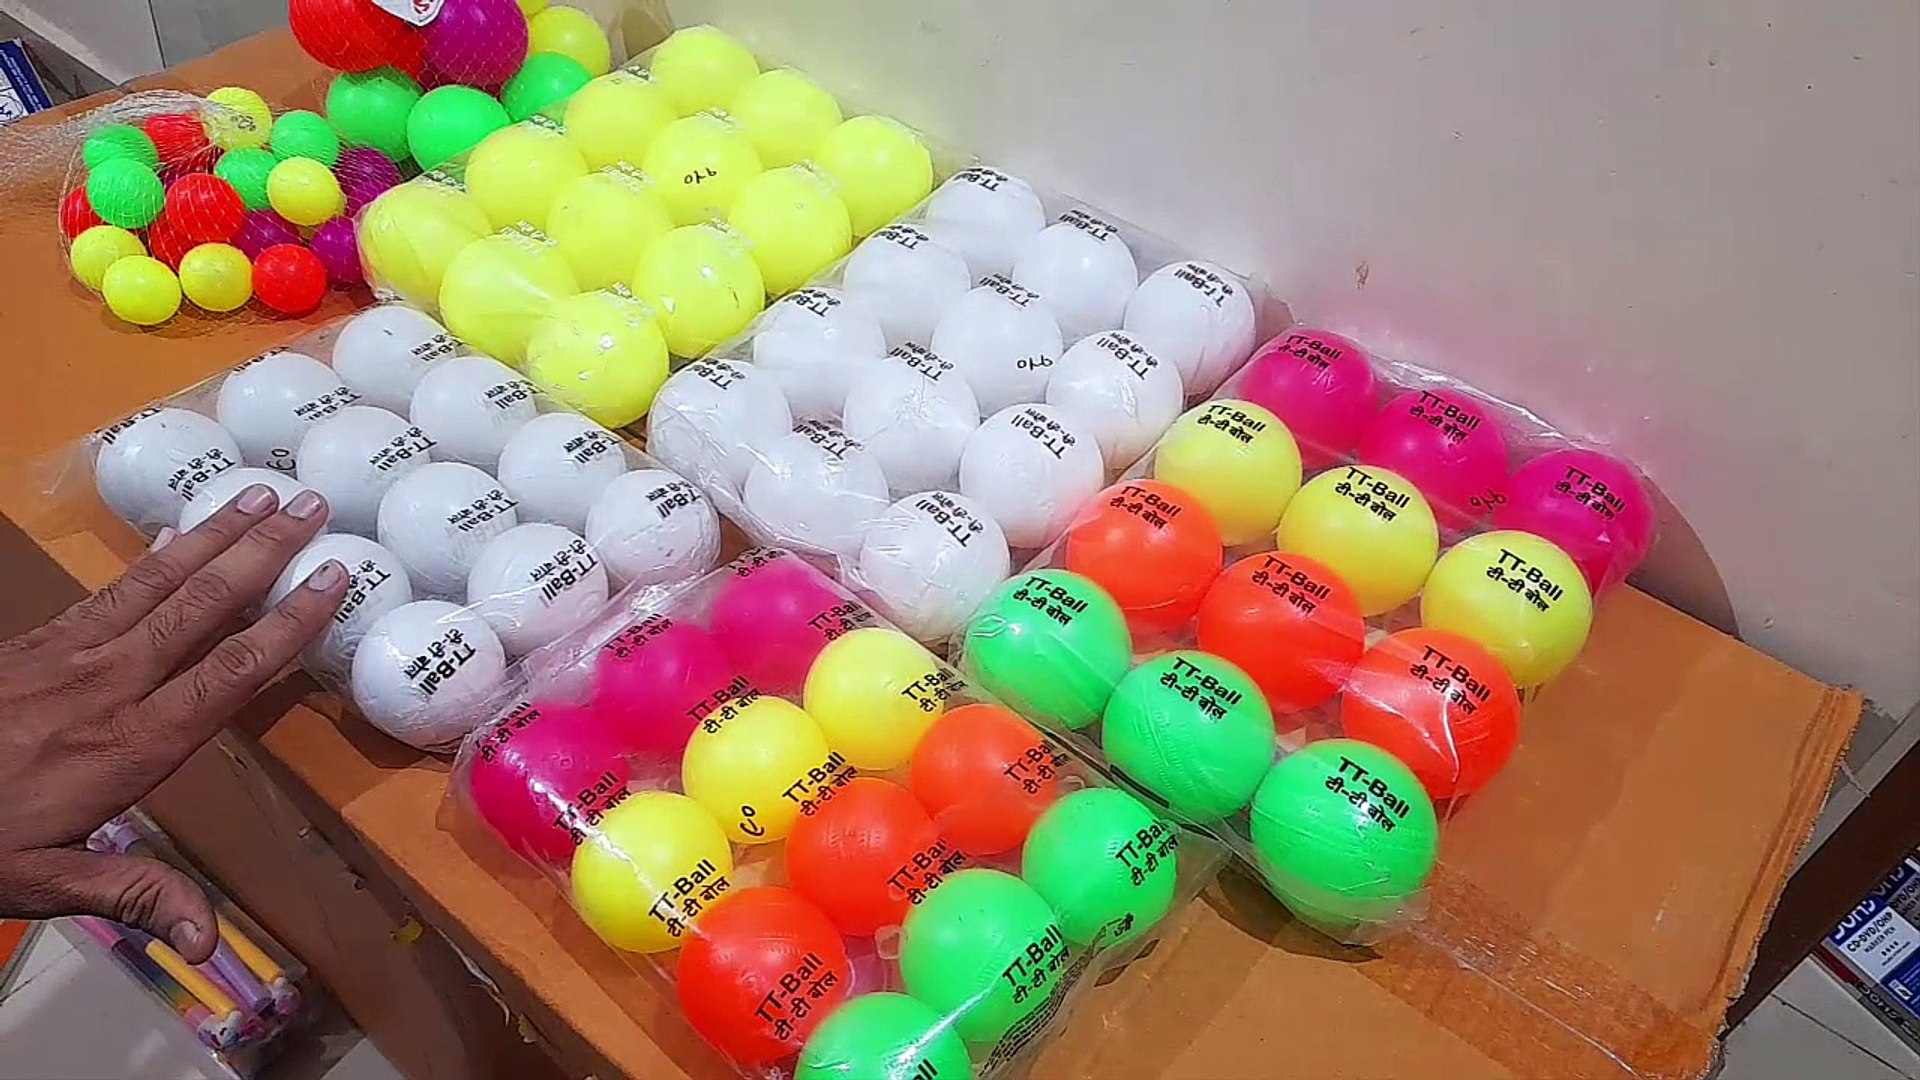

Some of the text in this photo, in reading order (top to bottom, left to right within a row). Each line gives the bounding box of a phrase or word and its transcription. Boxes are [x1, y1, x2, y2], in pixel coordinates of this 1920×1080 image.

[1059, 213, 1109, 242] TT-Ball
[979, 277, 1030, 307] TT-Ball
[1173, 268, 1225, 308] TT-Ball
[889, 347, 942, 381] TT-Ball
[1096, 336, 1149, 380] TT-Ball
[1286, 334, 1342, 361] TT-Ball
[1197, 414, 1230, 432] टी-टी
[1207, 404, 1267, 433] TT-Ball
[1409, 405, 1442, 426] टी-टी
[1421, 390, 1481, 431] TT-Ball
[377, 436, 438, 471] TT-Ball
[792, 424, 847, 460] TT-Ball
[1010, 414, 1065, 460] TT-Ball
[181, 457, 236, 502] TT-Ball
[1346, 467, 1411, 509] TT-Ball
[1566, 465, 1626, 513] TT-Ball
[458, 498, 519, 533] TT-Ball
[915, 499, 973, 547] TT-Ball
[1109, 497, 1168, 530] टी-टी बोल
[1120, 485, 1182, 518] TT-Ball
[1334, 482, 1397, 522] टी-टी बोल
[334, 567, 391, 624] TT-Ball
[542, 553, 599, 601] TT-Ball
[1024, 576, 1088, 614] TT-Ball
[1252, 569, 1316, 615] टी-टी बोल
[1263, 555, 1331, 601] TT-Ball
[1486, 566, 1549, 613] टी-टी बोल
[1499, 548, 1564, 601] TT-Ball
[807, 600, 863, 630] TT-Ball
[1013, 588, 1047, 610] टी-टी
[428, 628, 464, 658] टी-टी
[604, 613, 663, 650] TT-Ball
[418, 642, 477, 695] TT-Ball
[902, 667, 955, 700] TT-Ball
[1171, 656, 1243, 706] TT-Ball
[1410, 663, 1478, 715] टी-टी बोल
[1423, 645, 1491, 702] TT-Ball
[686, 675, 750, 722] TT-Ball
[1160, 672, 1228, 721] टी-टी बोल
[782, 751, 846, 803] TT-Ball
[1338, 756, 1410, 819] TT-Ball
[800, 784, 836, 817] टी-टी
[1325, 775, 1396, 833] टी-टी बोल
[648, 859, 717, 921] TT-Ball
[666, 876, 731, 937] टी-टी बोल
[907, 872, 943, 905] टी-टी
[1002, 924, 1063, 988] TT-Ball
[754, 952, 824, 1023] TT-Ball
[774, 970, 840, 1041] टी-टी बोल
[1012, 967, 1046, 1005] टी-टी
